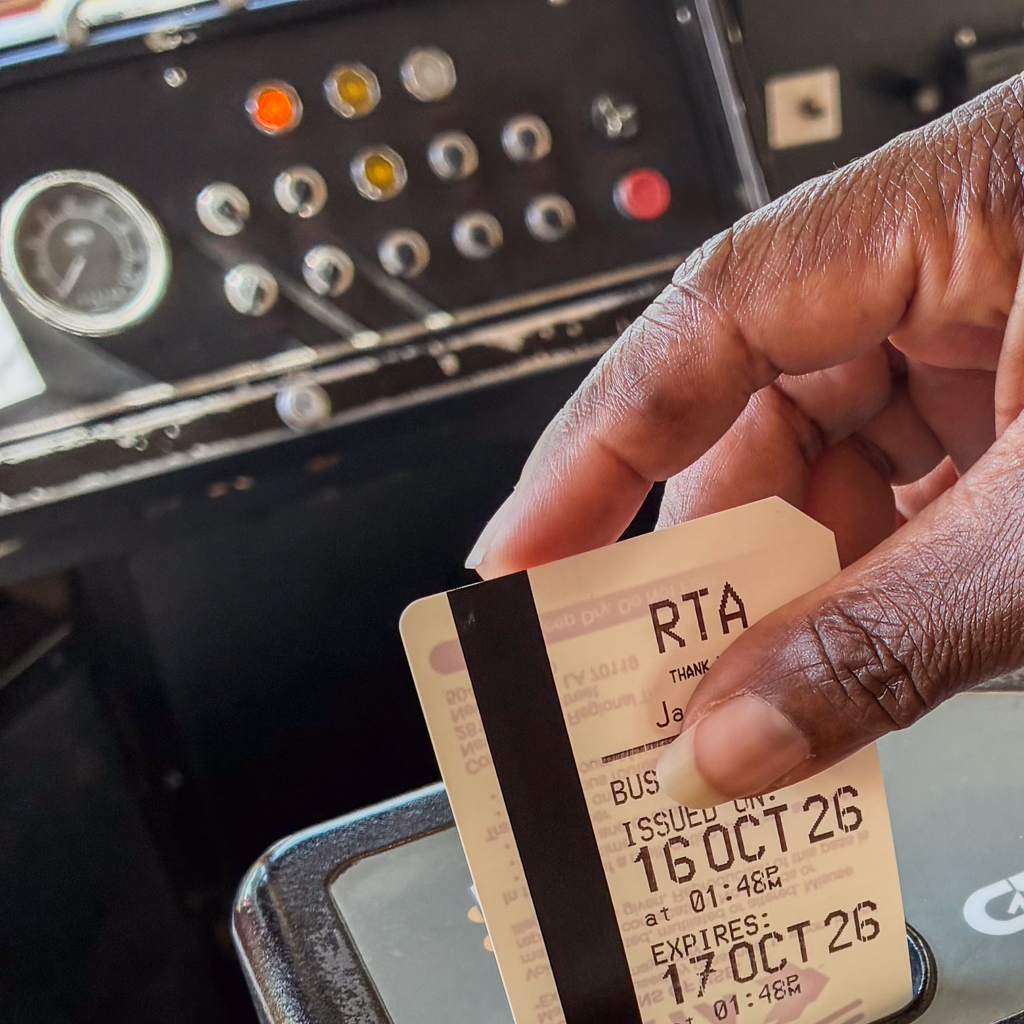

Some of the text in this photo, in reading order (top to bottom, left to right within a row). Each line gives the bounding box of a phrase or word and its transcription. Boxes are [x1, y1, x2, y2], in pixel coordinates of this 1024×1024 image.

[649, 582, 748, 654] RTA
[669, 659, 709, 683] THANK
[609, 769, 660, 806] BUS
[622, 806, 717, 847] ISSUED
[645, 907, 670, 926] at
[650, 912, 770, 966] EXPIRES:
